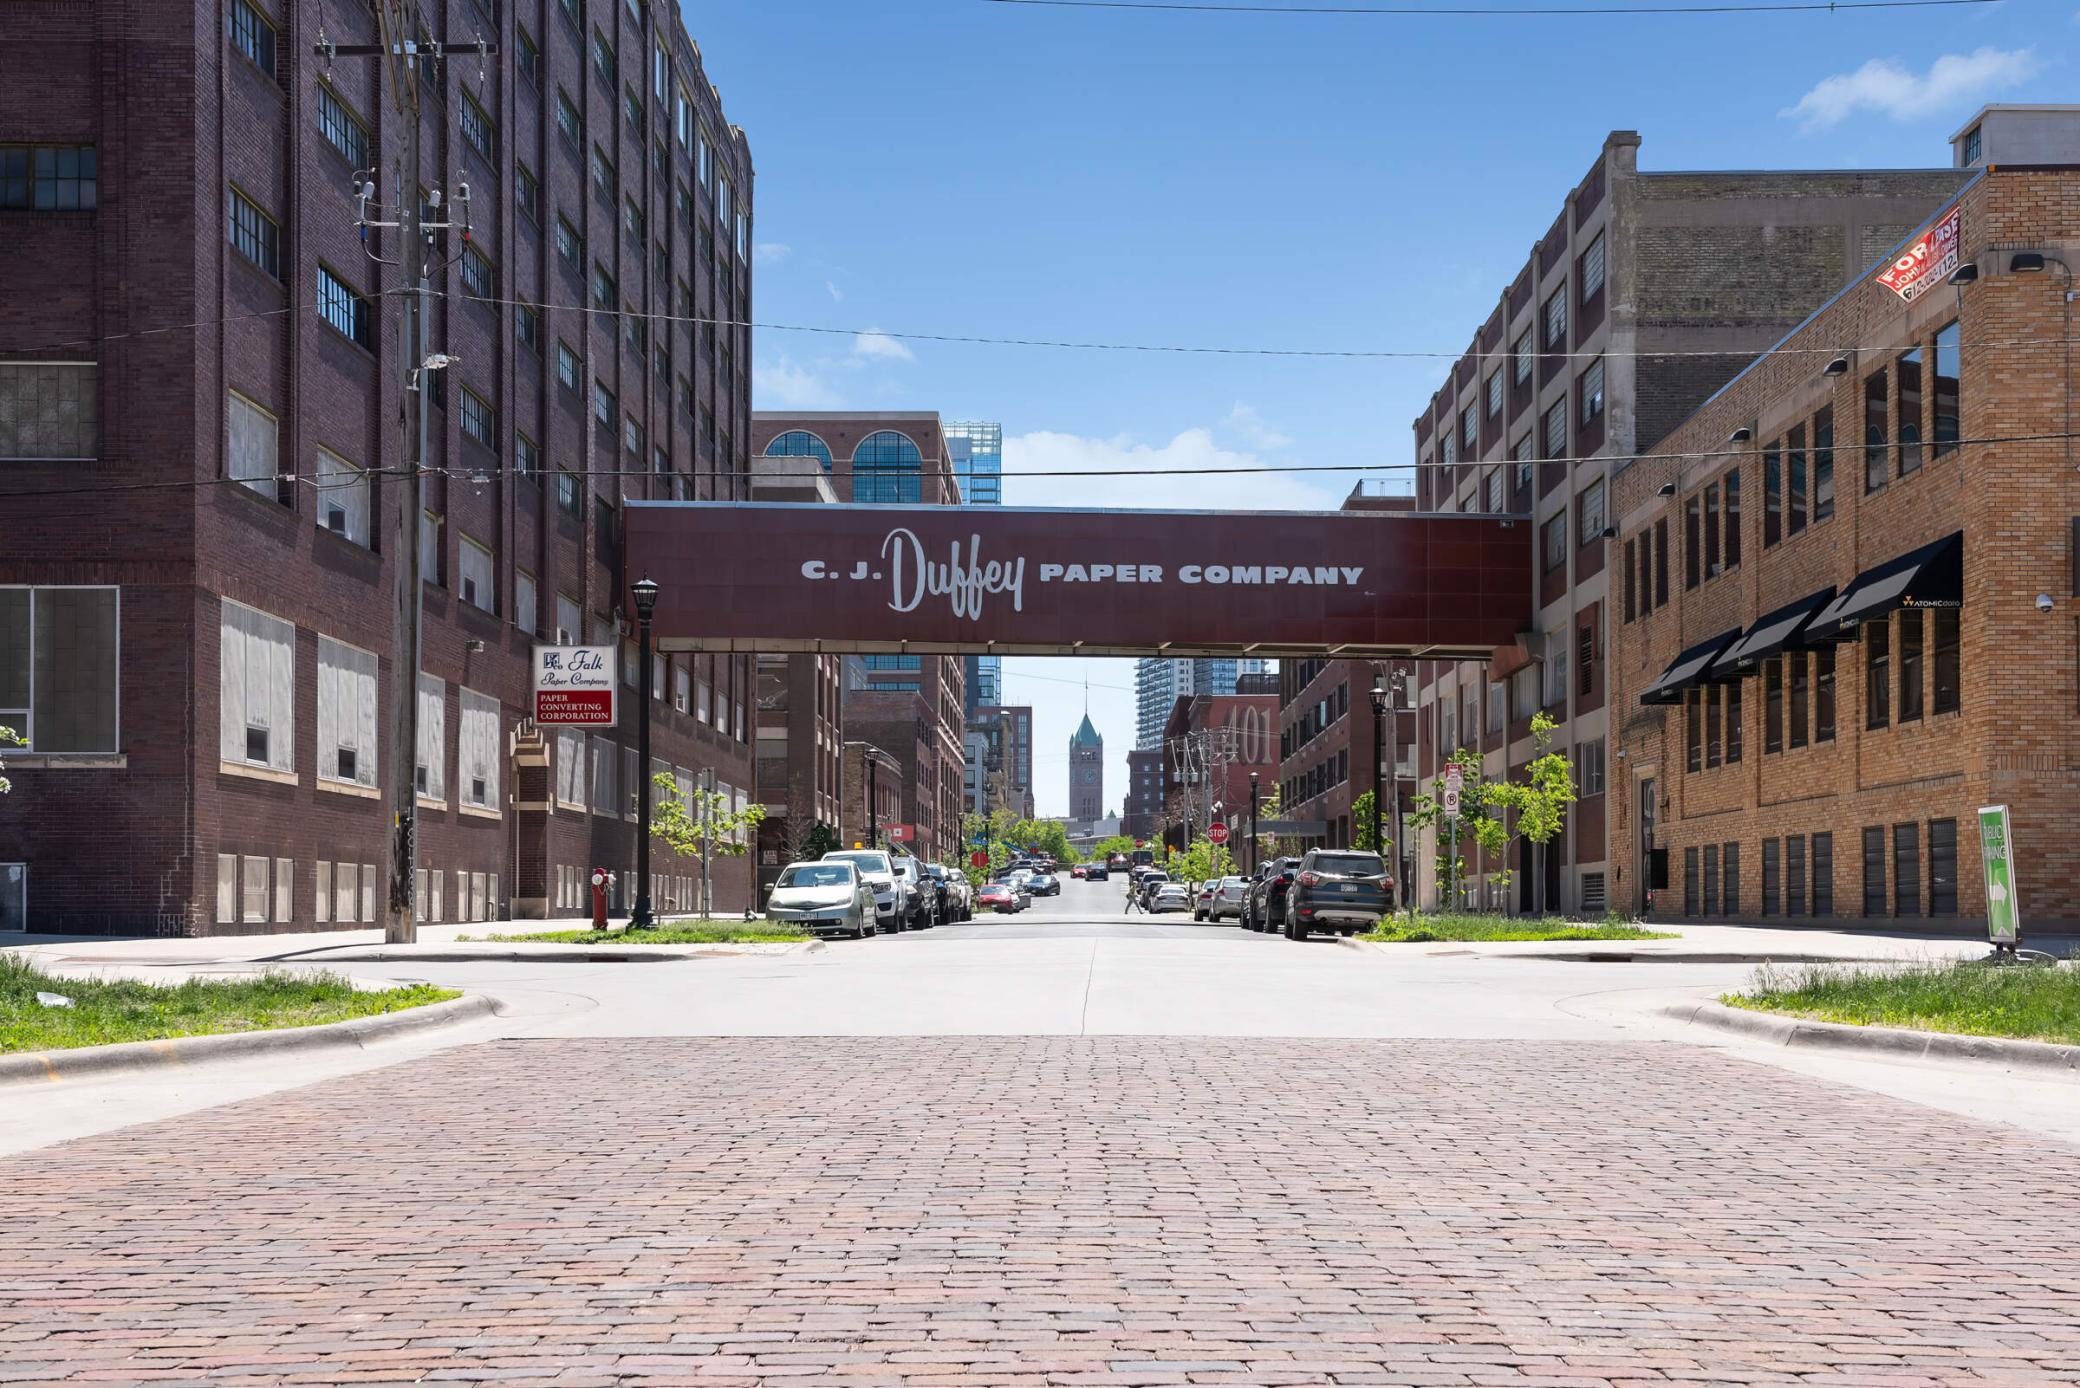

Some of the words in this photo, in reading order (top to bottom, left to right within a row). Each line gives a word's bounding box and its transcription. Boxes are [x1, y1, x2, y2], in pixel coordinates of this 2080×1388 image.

[1880, 242, 1928, 283] FOR
[802, 561, 838, 579] C.
[850, 561, 881, 580] J.
[882, 527, 1025, 621] Duffey
[1041, 564, 1162, 583] PAPER
[1179, 566, 1364, 585] COMPANY
[568, 650, 603, 671] Falk
[541, 671, 568, 686] Paper
[570, 671, 608, 686] Company
[541, 703, 601, 711] CONVERTING
[541, 712, 609, 720] CORPORATION
[1223, 704, 1273, 764] 401
[1208, 828, 1228, 838] STOP
